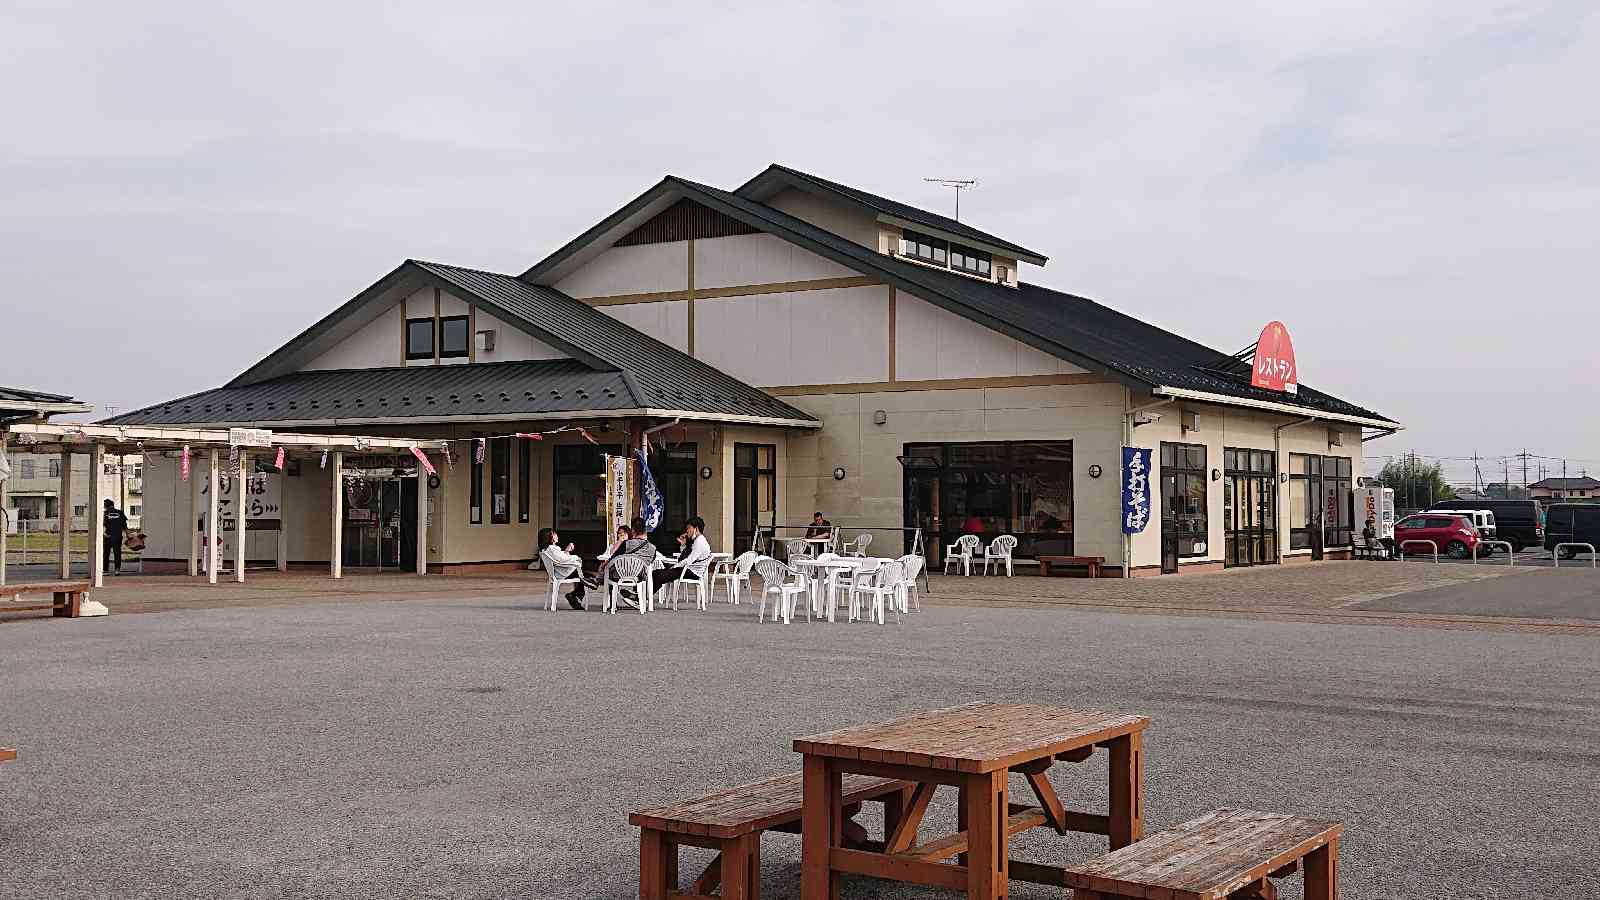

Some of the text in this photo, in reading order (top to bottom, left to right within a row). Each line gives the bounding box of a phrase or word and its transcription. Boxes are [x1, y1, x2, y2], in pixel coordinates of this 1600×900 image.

[1258, 355, 1293, 381] レストラン
[1127, 451, 1147, 528] 手打そば
